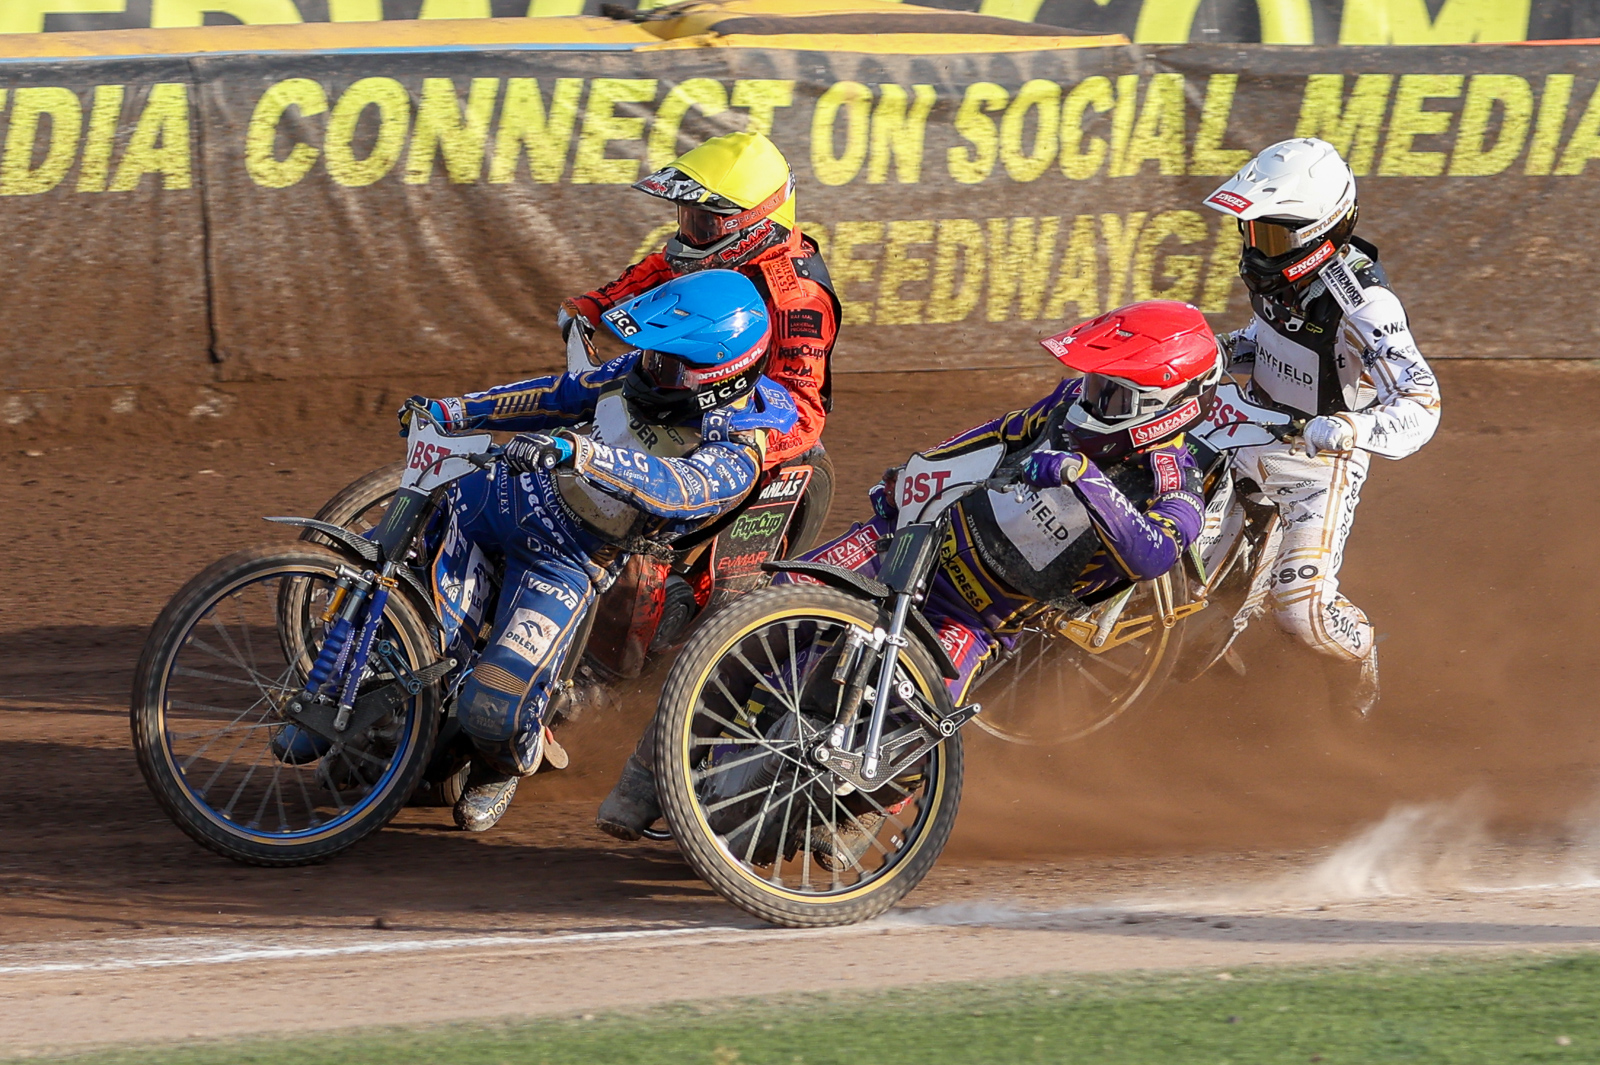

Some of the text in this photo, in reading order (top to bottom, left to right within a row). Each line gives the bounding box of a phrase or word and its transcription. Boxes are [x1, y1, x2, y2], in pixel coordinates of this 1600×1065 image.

[0, 83, 192, 196] DIA
[245, 77, 796, 188] CONNECT
[810, 80, 936, 186] ON
[946, 73, 1252, 184] SOCIAL
[1287, 243, 1332, 278] ENGEL
[606, 309, 638, 337] MCG
[699, 376, 748, 410] MCG
[1147, 403, 1198, 437] IMPAKT
[1207, 395, 1251, 438] BST
[410, 440, 452, 476] BST
[591, 439, 650, 473] MCG
[758, 479, 803, 500] ANLAS
[902, 470, 952, 508] BST
[527, 577, 579, 611] verva
[941, 547, 984, 610] EXPRESS
[505, 631, 539, 655] ORLEN
